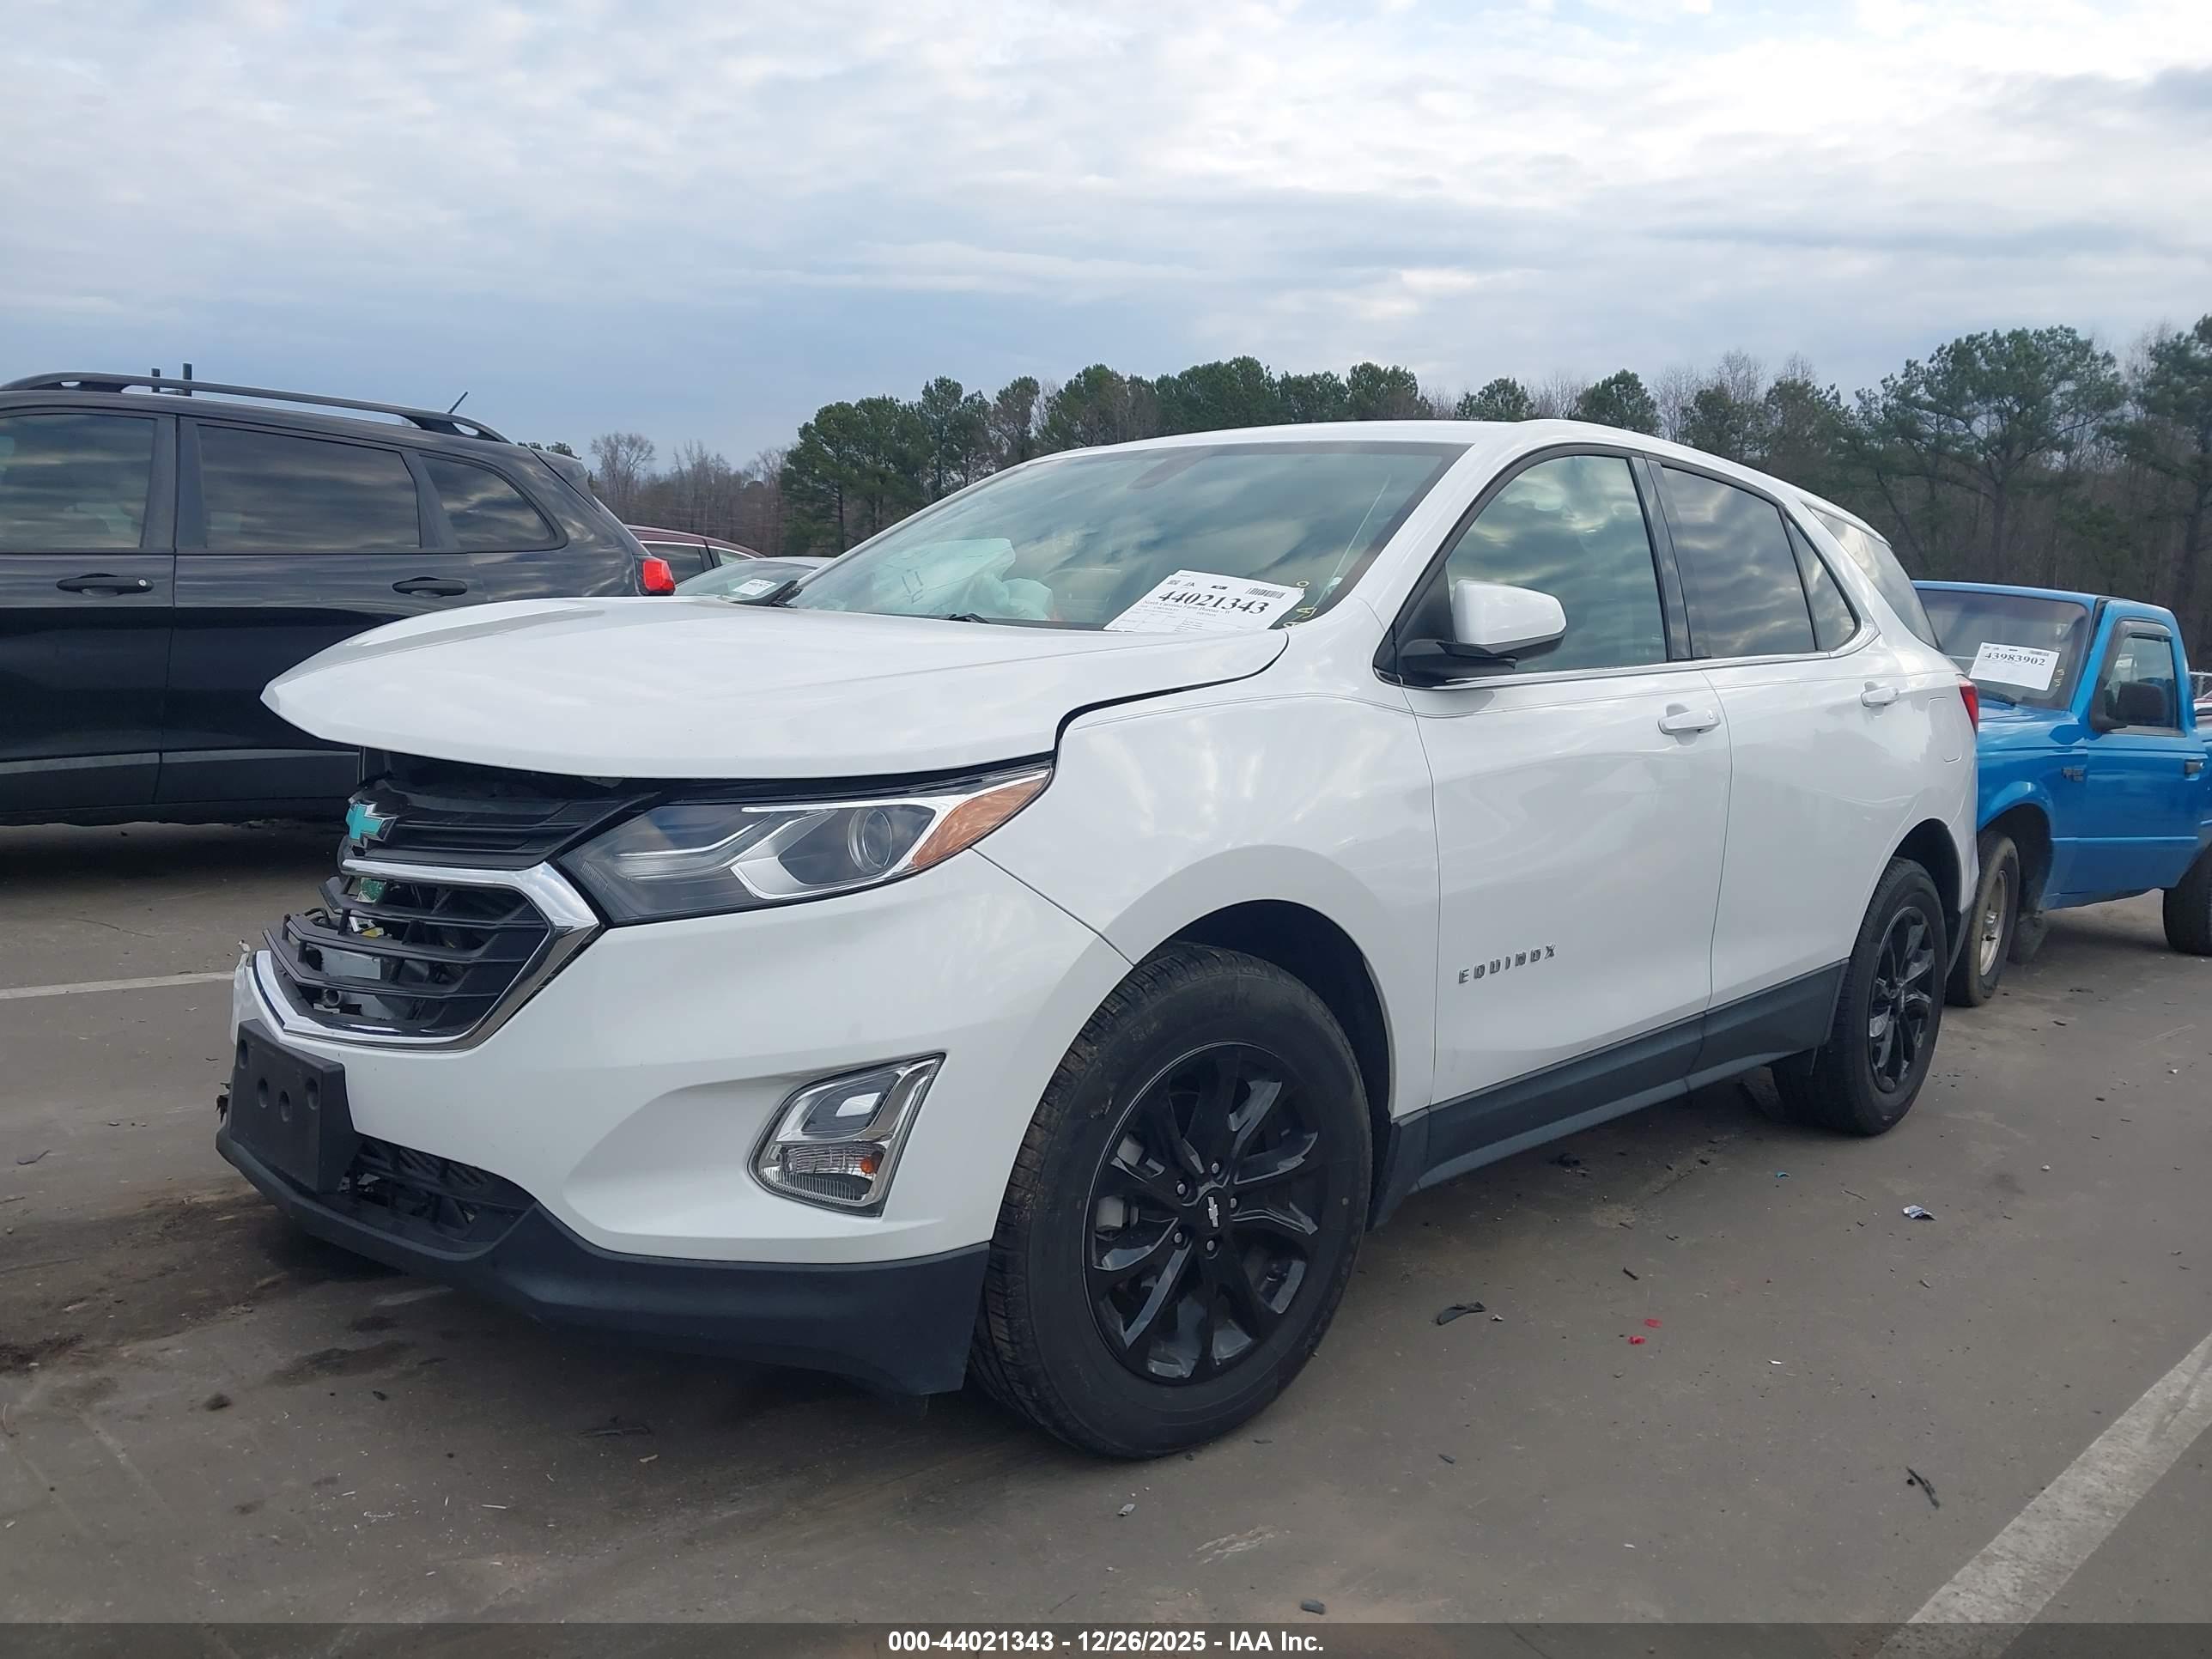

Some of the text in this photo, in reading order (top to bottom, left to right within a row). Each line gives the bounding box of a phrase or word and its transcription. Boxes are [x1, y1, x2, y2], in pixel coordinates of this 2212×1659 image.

[1158, 590, 1269, 615] 44021343
[1984, 652, 2046, 666] 43983902
[1458, 945, 1556, 984] EQUINOX
